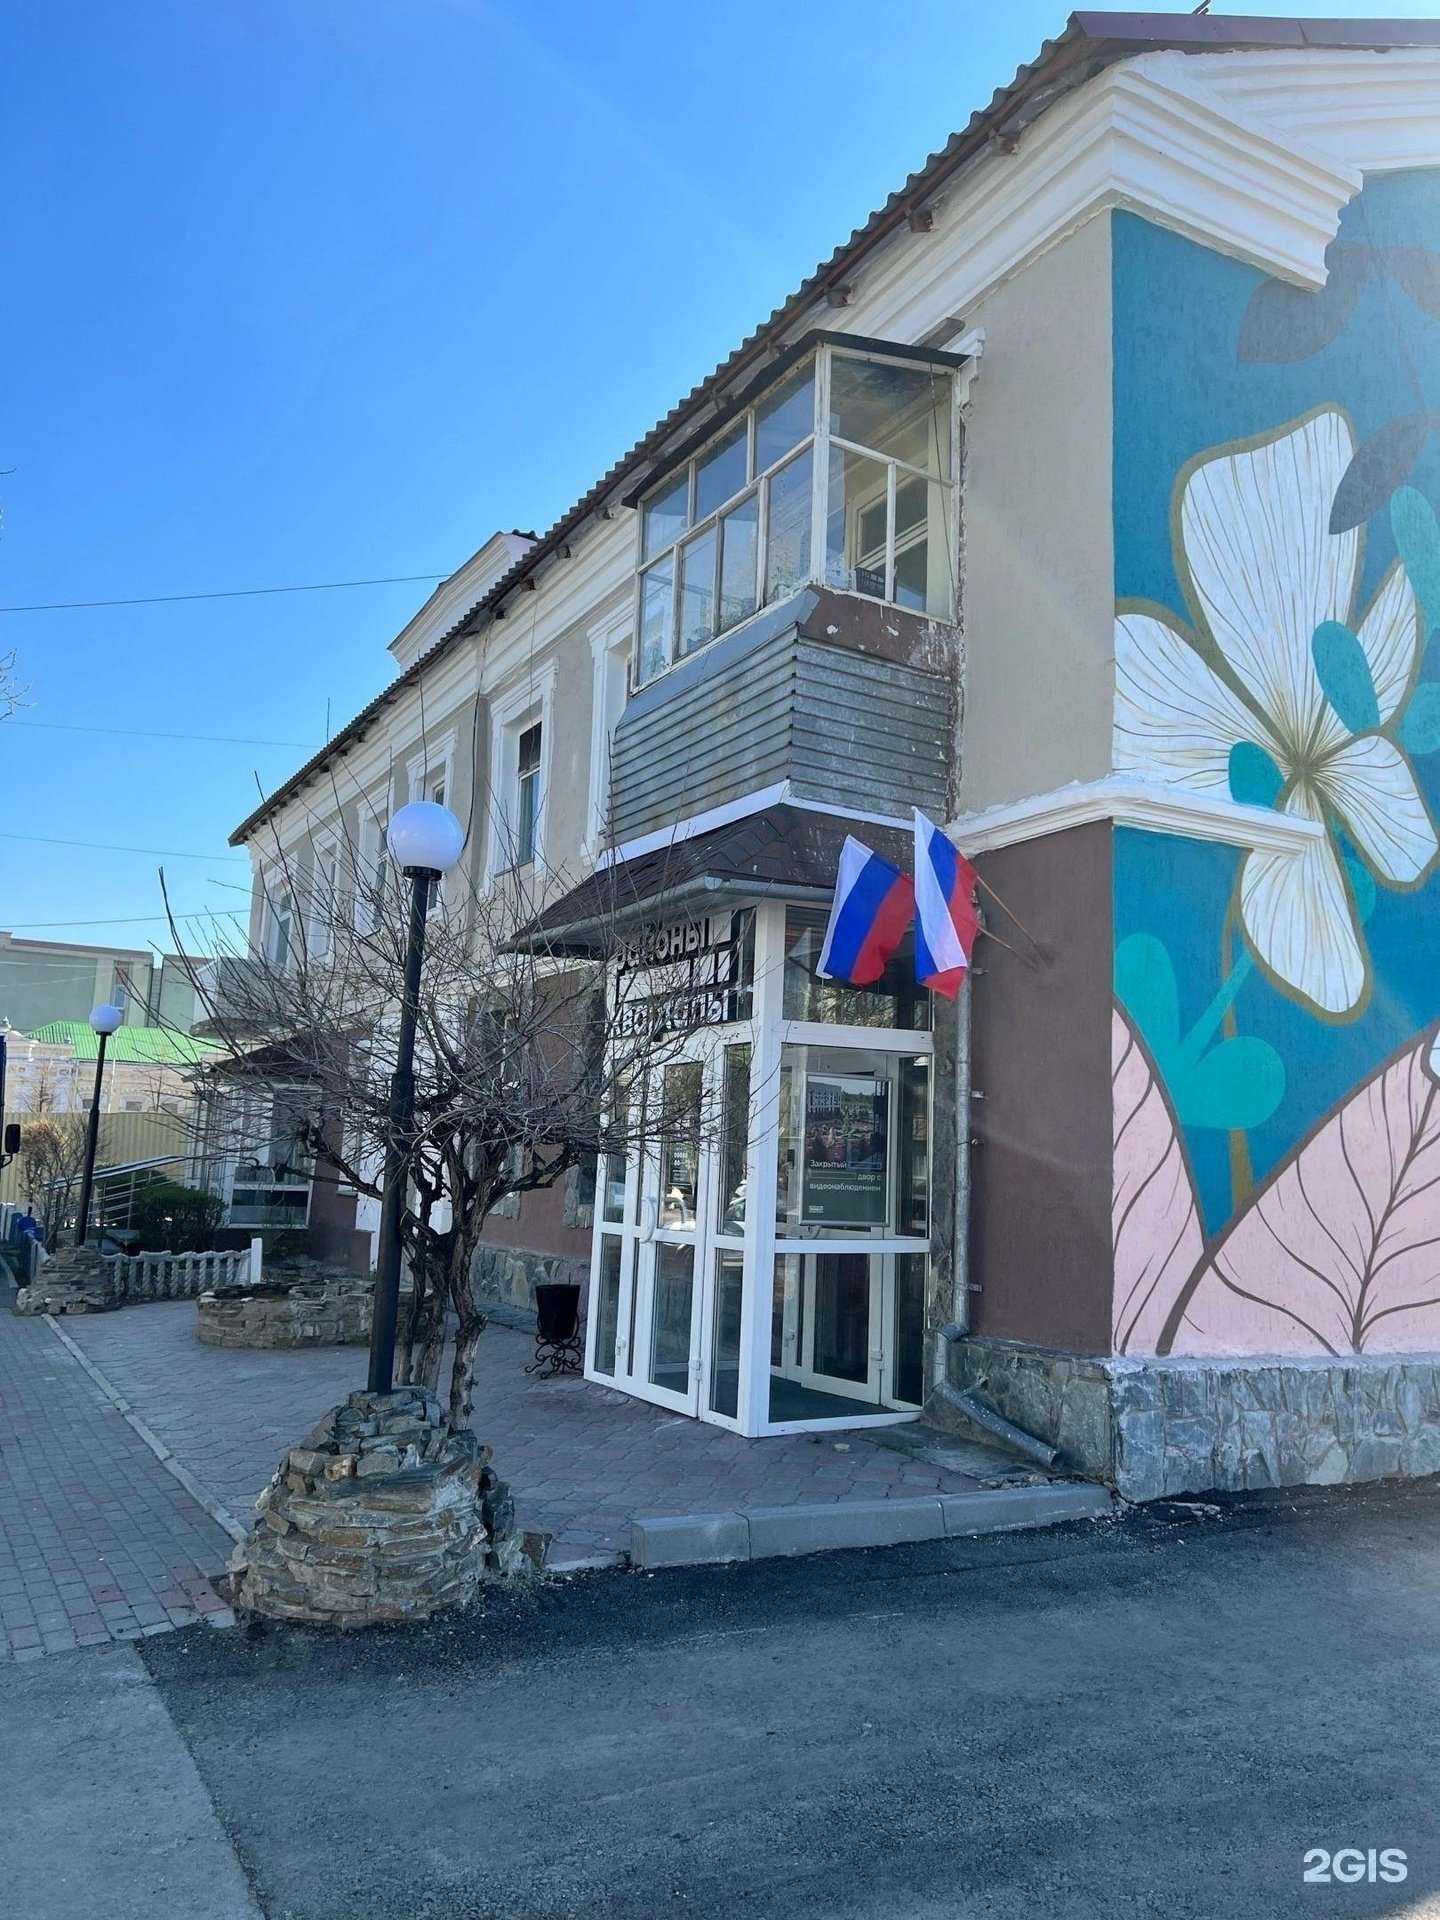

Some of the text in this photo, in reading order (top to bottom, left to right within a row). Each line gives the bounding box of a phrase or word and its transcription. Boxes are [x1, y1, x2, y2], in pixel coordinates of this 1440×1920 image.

[604, 989, 729, 1040] кваалы
[810, 1159, 848, 1169] Закрытый
[857, 1174, 876, 1182] двор
[809, 1183, 881, 1191] видеонаблюдением
